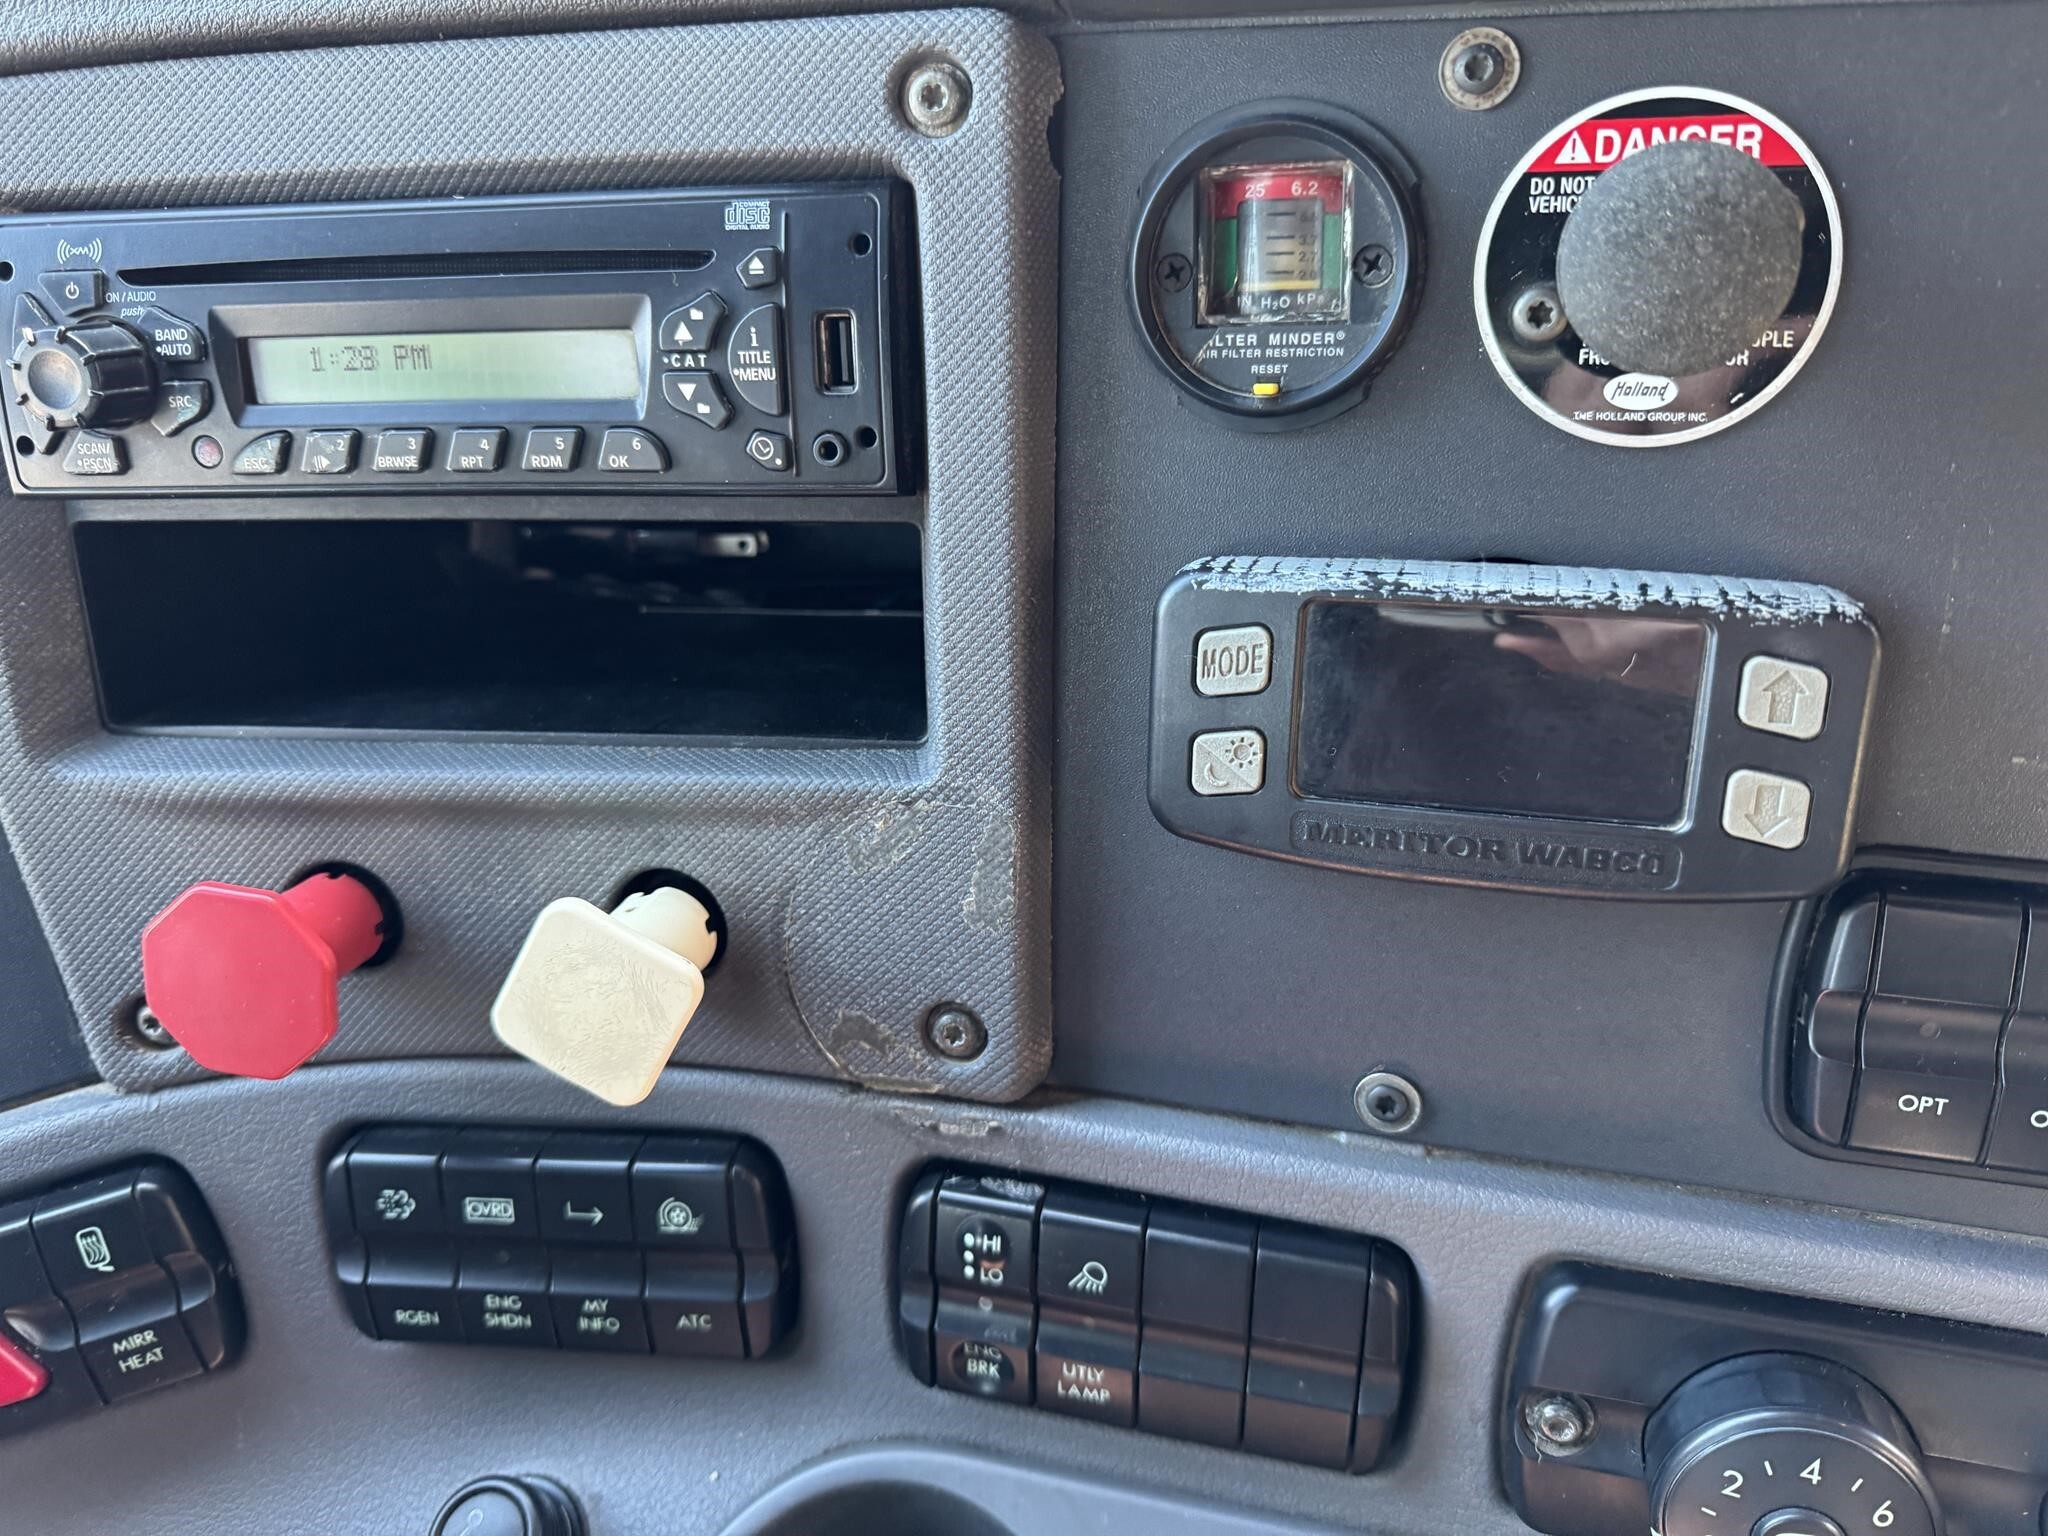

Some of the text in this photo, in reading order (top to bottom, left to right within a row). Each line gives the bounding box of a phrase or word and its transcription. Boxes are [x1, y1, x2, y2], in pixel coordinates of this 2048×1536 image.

[1244, 180, 1319, 199] 25 6.2
[1530, 176, 1596, 195] DO NOT
[1528, 196, 1582, 214] VEHIC
[105, 292, 120, 303] ON
[127, 290, 157, 302] AUDIO
[121, 306, 145, 319] push
[154, 328, 188, 342] BAND
[392, 344, 432, 371] PM
[737, 350, 772, 364] TITLE
[1221, 348, 1261, 359] FILTER
[1265, 347, 1345, 358] RESTRICTION
[1250, 364, 1289, 374] RESET
[1611, 380, 1670, 402] Holland
[168, 395, 193, 408] SRC
[1595, 410, 1646, 422] HOLLAND
[336, 439, 345, 452] 2
[407, 437, 417, 450] 3
[480, 438, 490, 451] 4
[555, 437, 565, 450] 5
[632, 437, 642, 451] 6
[244, 457, 267, 469] ESC
[377, 456, 418, 468] BRWSE
[461, 456, 484, 469] RPT
[531, 455, 563, 468] RDM
[609, 455, 630, 468] OK
[1201, 642, 1264, 679] MODE
[1302, 818, 1665, 876] MERITOR WABCO
[1898, 1094, 1950, 1116] OPT
[470, 1200, 513, 1218] OVRD
[982, 1234, 1002, 1253] HI
[980, 1267, 1004, 1285] LO
[483, 1294, 522, 1310] ENG
[582, 1299, 608, 1314] MY
[395, 1308, 440, 1325] RGEN
[483, 1312, 532, 1329] SHDN
[578, 1315, 620, 1334] INFO
[676, 1314, 712, 1330] ATC
[112, 1329, 158, 1355] MIRR
[118, 1346, 164, 1373] HEAT
[965, 1357, 1001, 1379] BRK
[1061, 1361, 1105, 1384] UTLY
[1056, 1379, 1111, 1405] LAMP
[1799, 1457, 1822, 1485] 4
[1720, 1469, 1744, 1499] 2
[1872, 1500, 1895, 1527] 6
